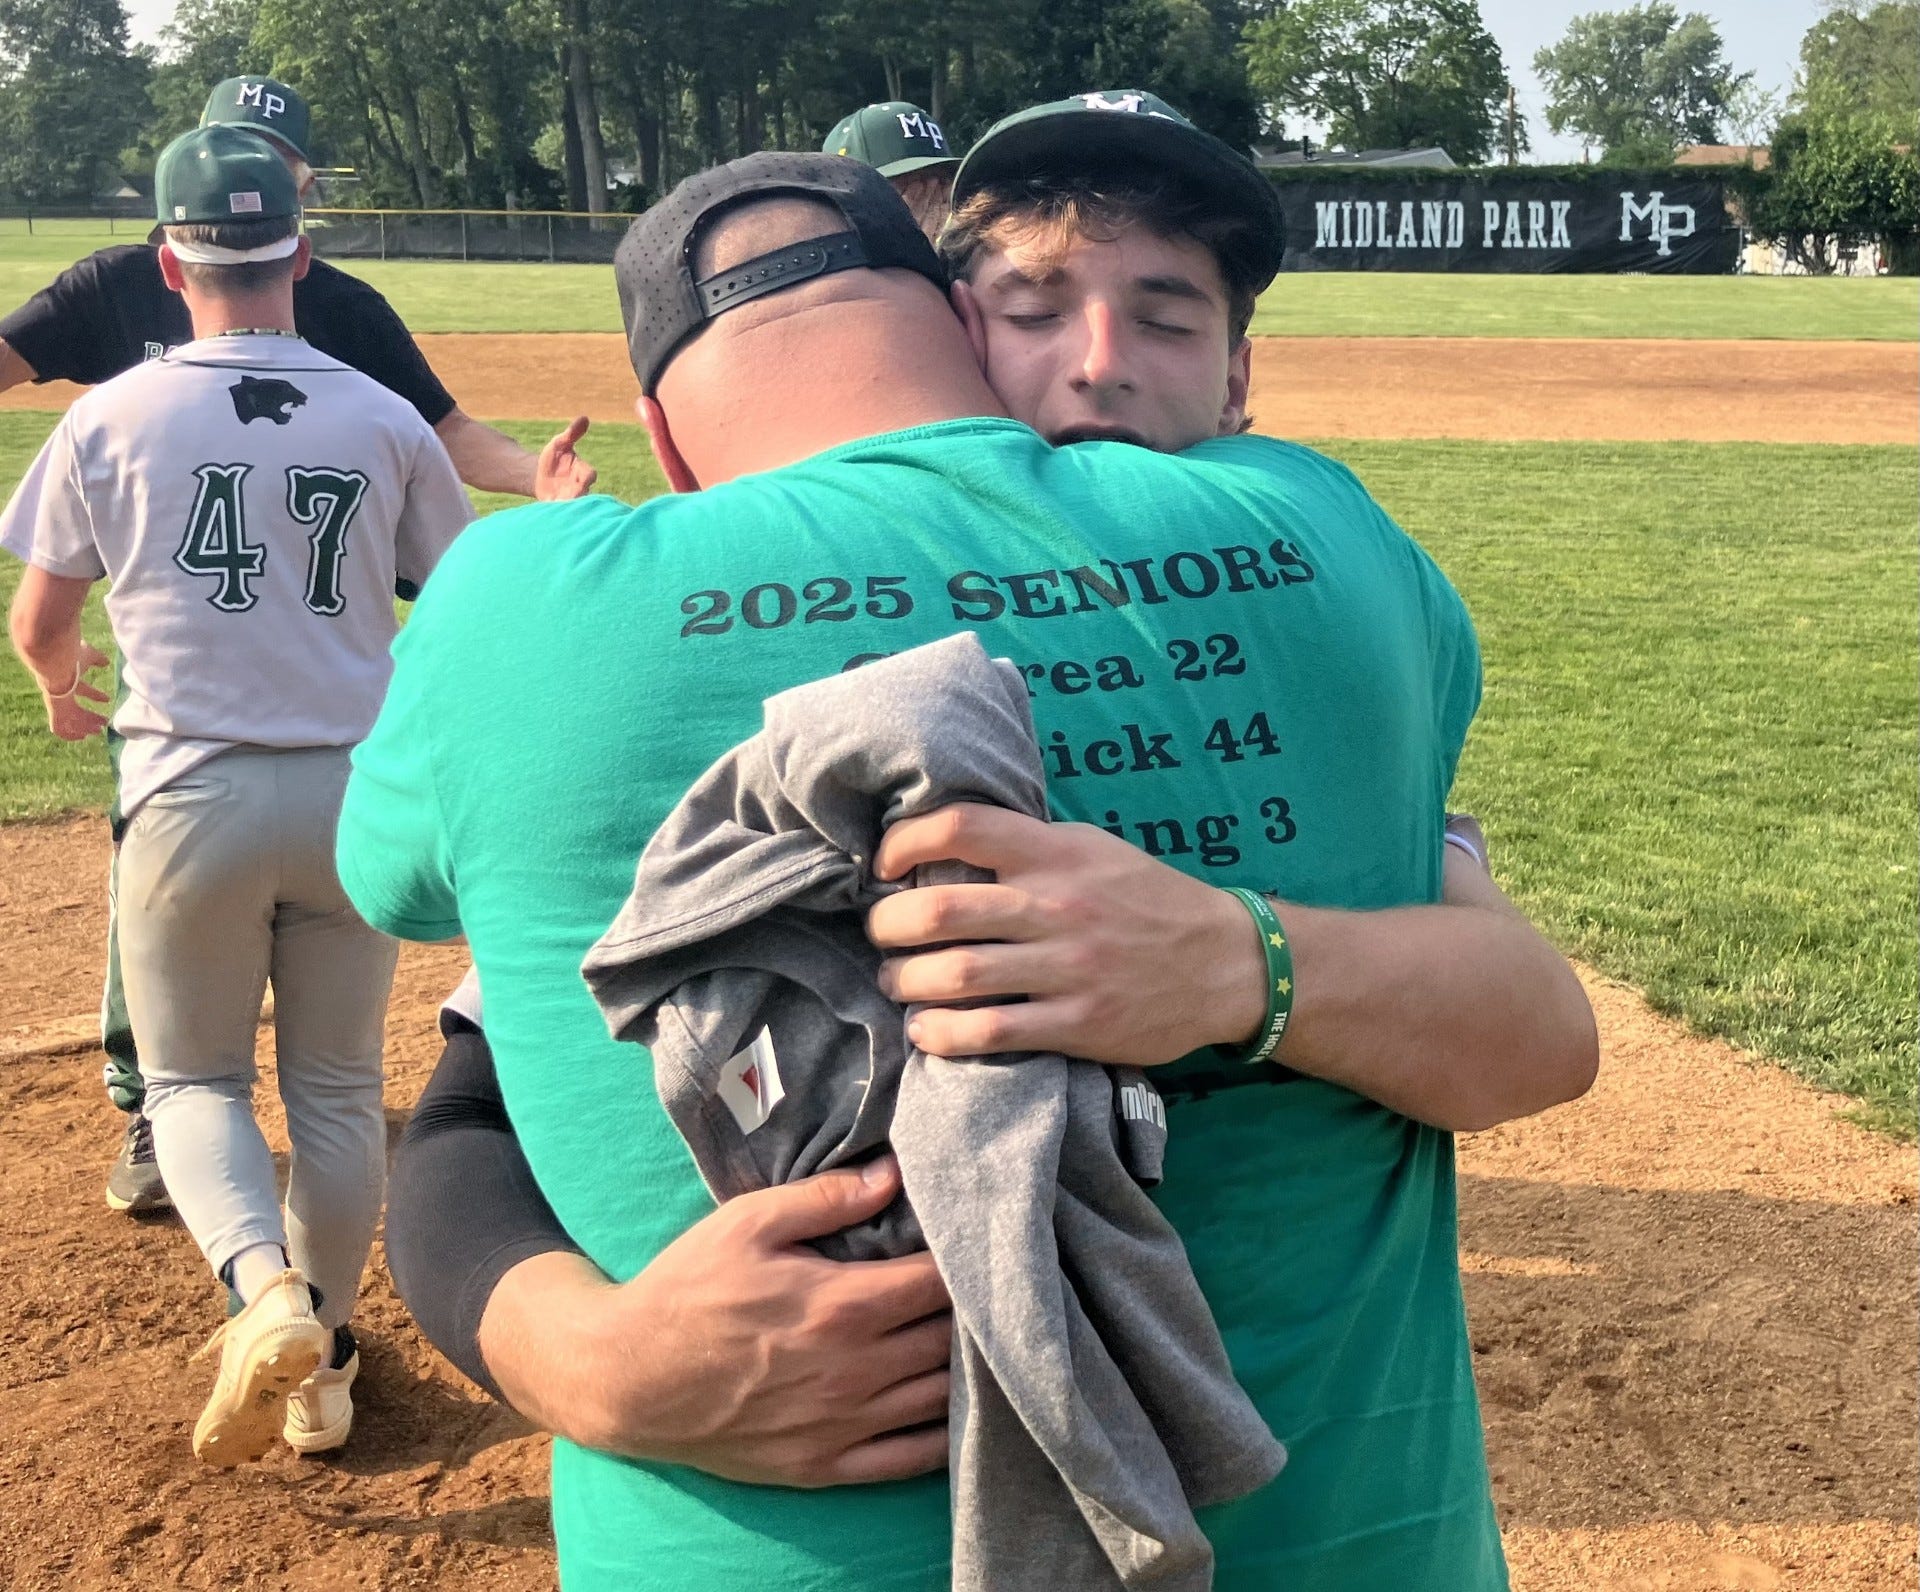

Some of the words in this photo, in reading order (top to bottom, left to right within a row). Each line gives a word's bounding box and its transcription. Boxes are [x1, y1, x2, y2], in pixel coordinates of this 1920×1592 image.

[235, 83, 286, 120] MP
[896, 112, 944, 149] MP
[1314, 200, 1465, 249] MIDLAND
[1482, 200, 1572, 249] PARK
[1618, 190, 1696, 257] MP
[173, 462, 371, 617] 47
[680, 576, 914, 637] 2025
[947, 539, 1315, 621] SENIORS
[1166, 632, 1246, 682] 22
[1204, 711, 1281, 763] 44
[1259, 796, 1297, 844] 3
[1271, 1011, 1288, 1033] THE
